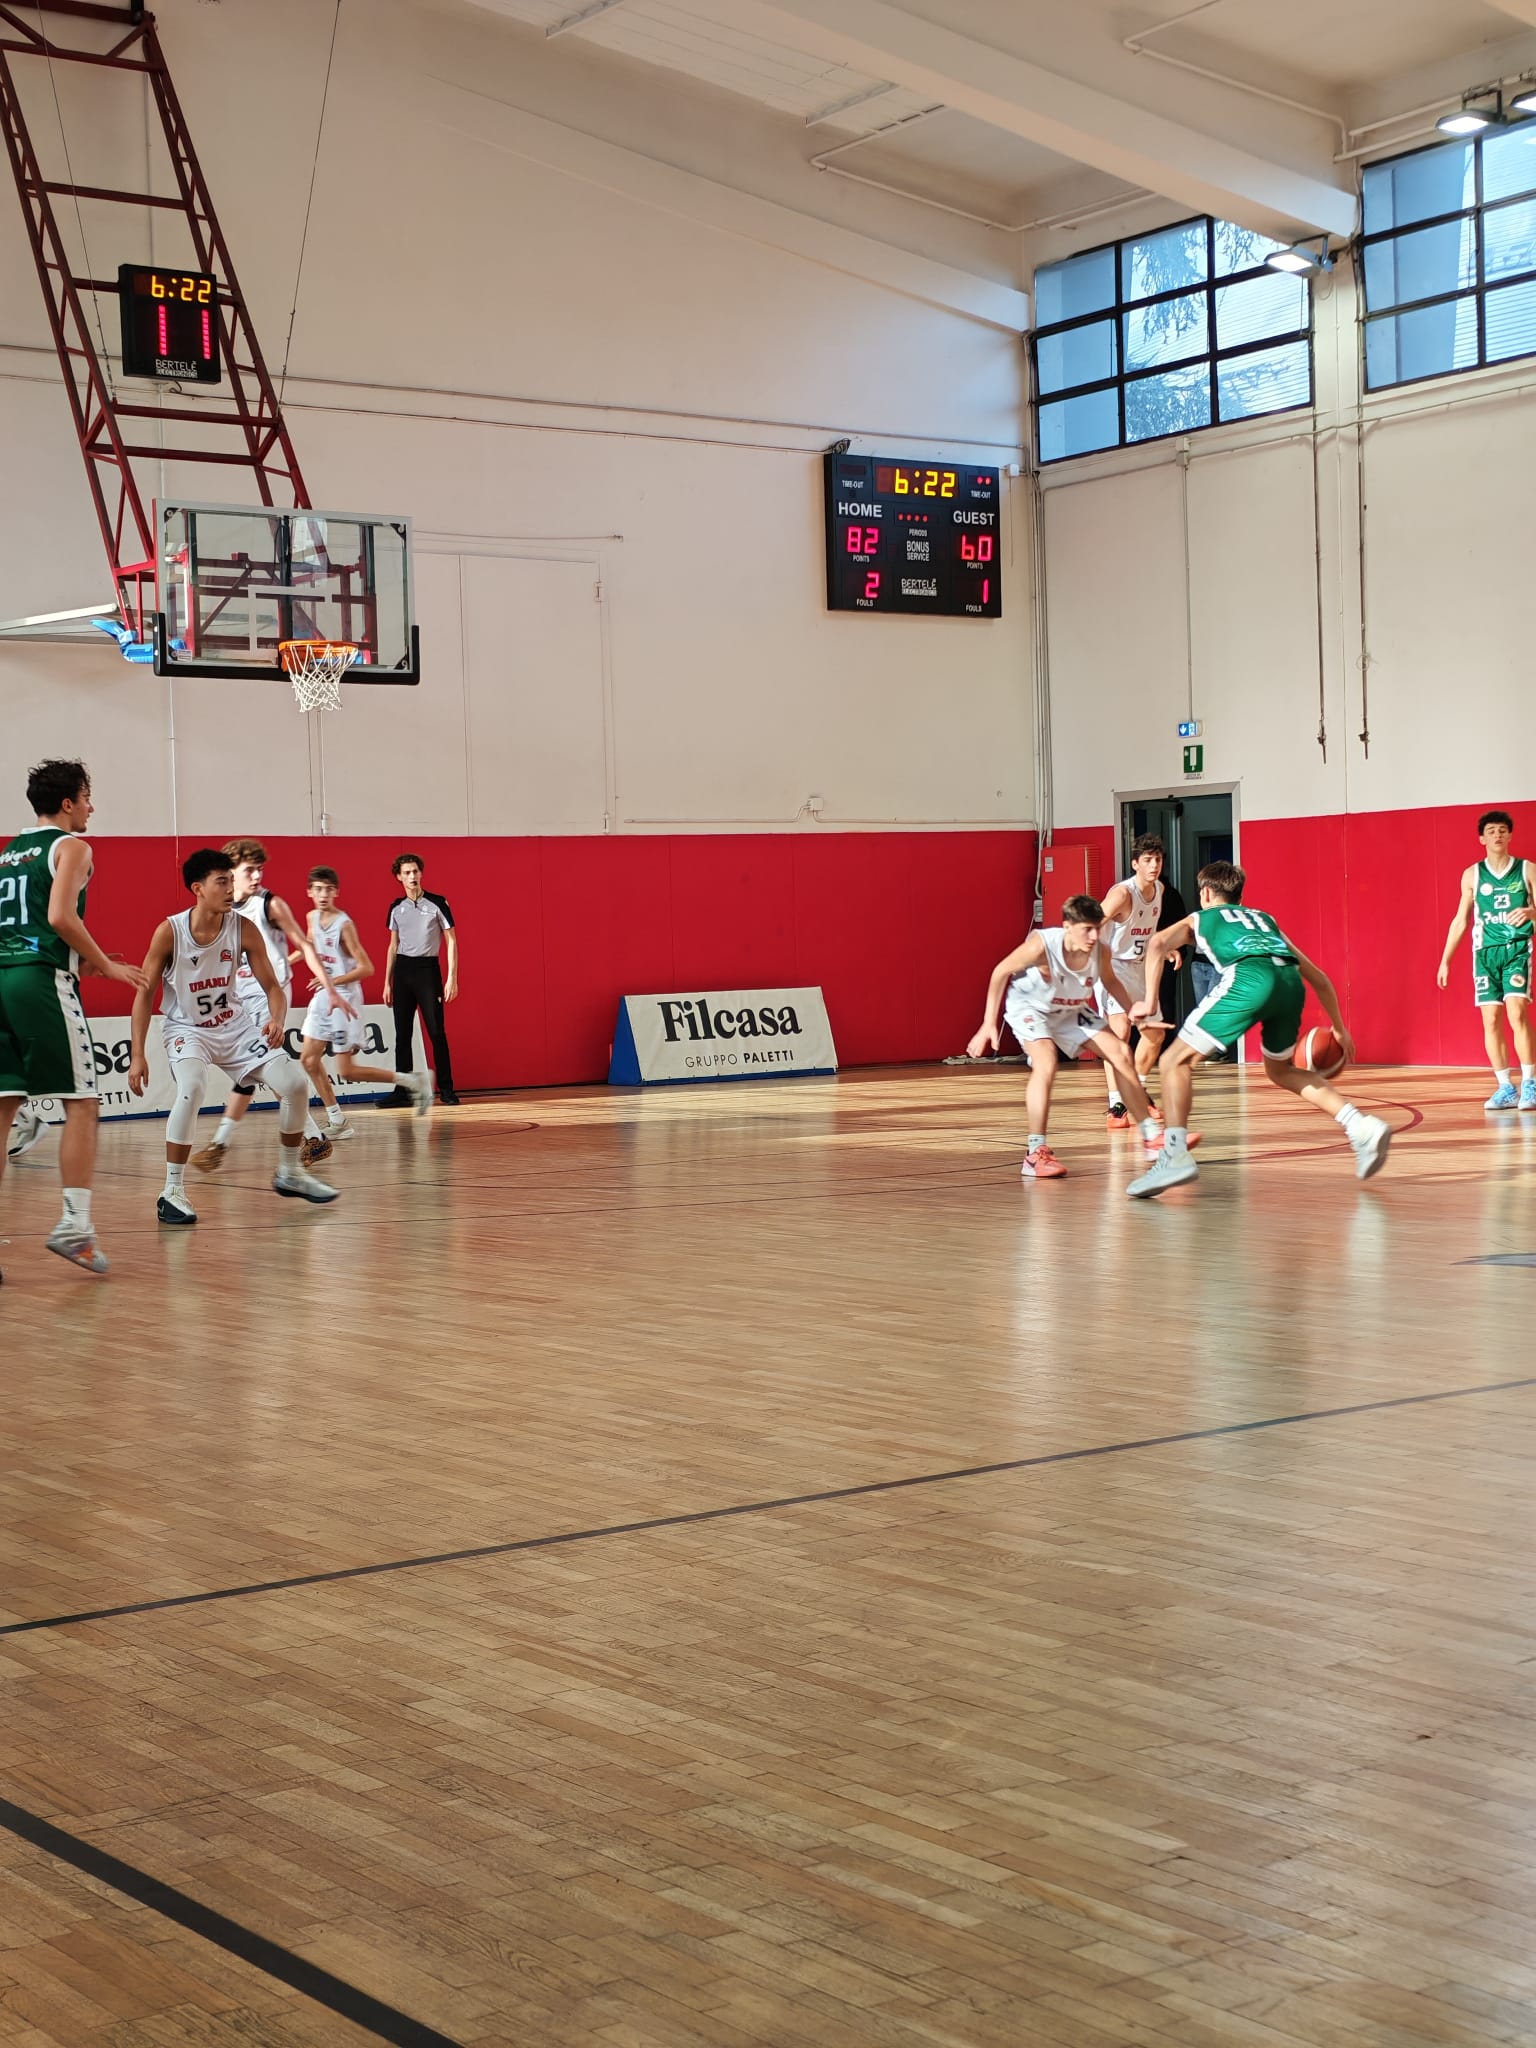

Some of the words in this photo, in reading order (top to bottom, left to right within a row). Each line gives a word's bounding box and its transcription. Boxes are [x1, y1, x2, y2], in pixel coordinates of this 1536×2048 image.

[151, 275, 211, 303] 6:22
[842, 480, 864, 488] TIME-OUT
[895, 468, 955, 498] 6:22
[971, 490, 991, 499] TIME-OUT
[838, 501, 883, 518] HOME
[953, 510, 995, 526] GUEST
[847, 526, 879, 555] 82
[909, 528, 927, 537] PERIODS
[906, 540, 930, 553] BONUS
[961, 534, 992, 562] 60
[853, 555, 870, 563] POINTS
[907, 552, 930, 562] SERVICE
[967, 562, 983, 570] POINTS
[865, 572, 880, 599] 2
[983, 578, 989, 605] 1
[856, 598, 874, 607] FOULS
[965, 604, 982, 613] FOULS
[1483, 911, 1507, 925] Pell
[1134, 940, 1144, 955] 5
[197, 993, 228, 1016] 54
[657, 999, 802, 1043] Filcasa
[247, 1039, 268, 1059] 5
[685, 1053, 738, 1068] GRUPPO
[744, 1050, 794, 1064] PALETTI
